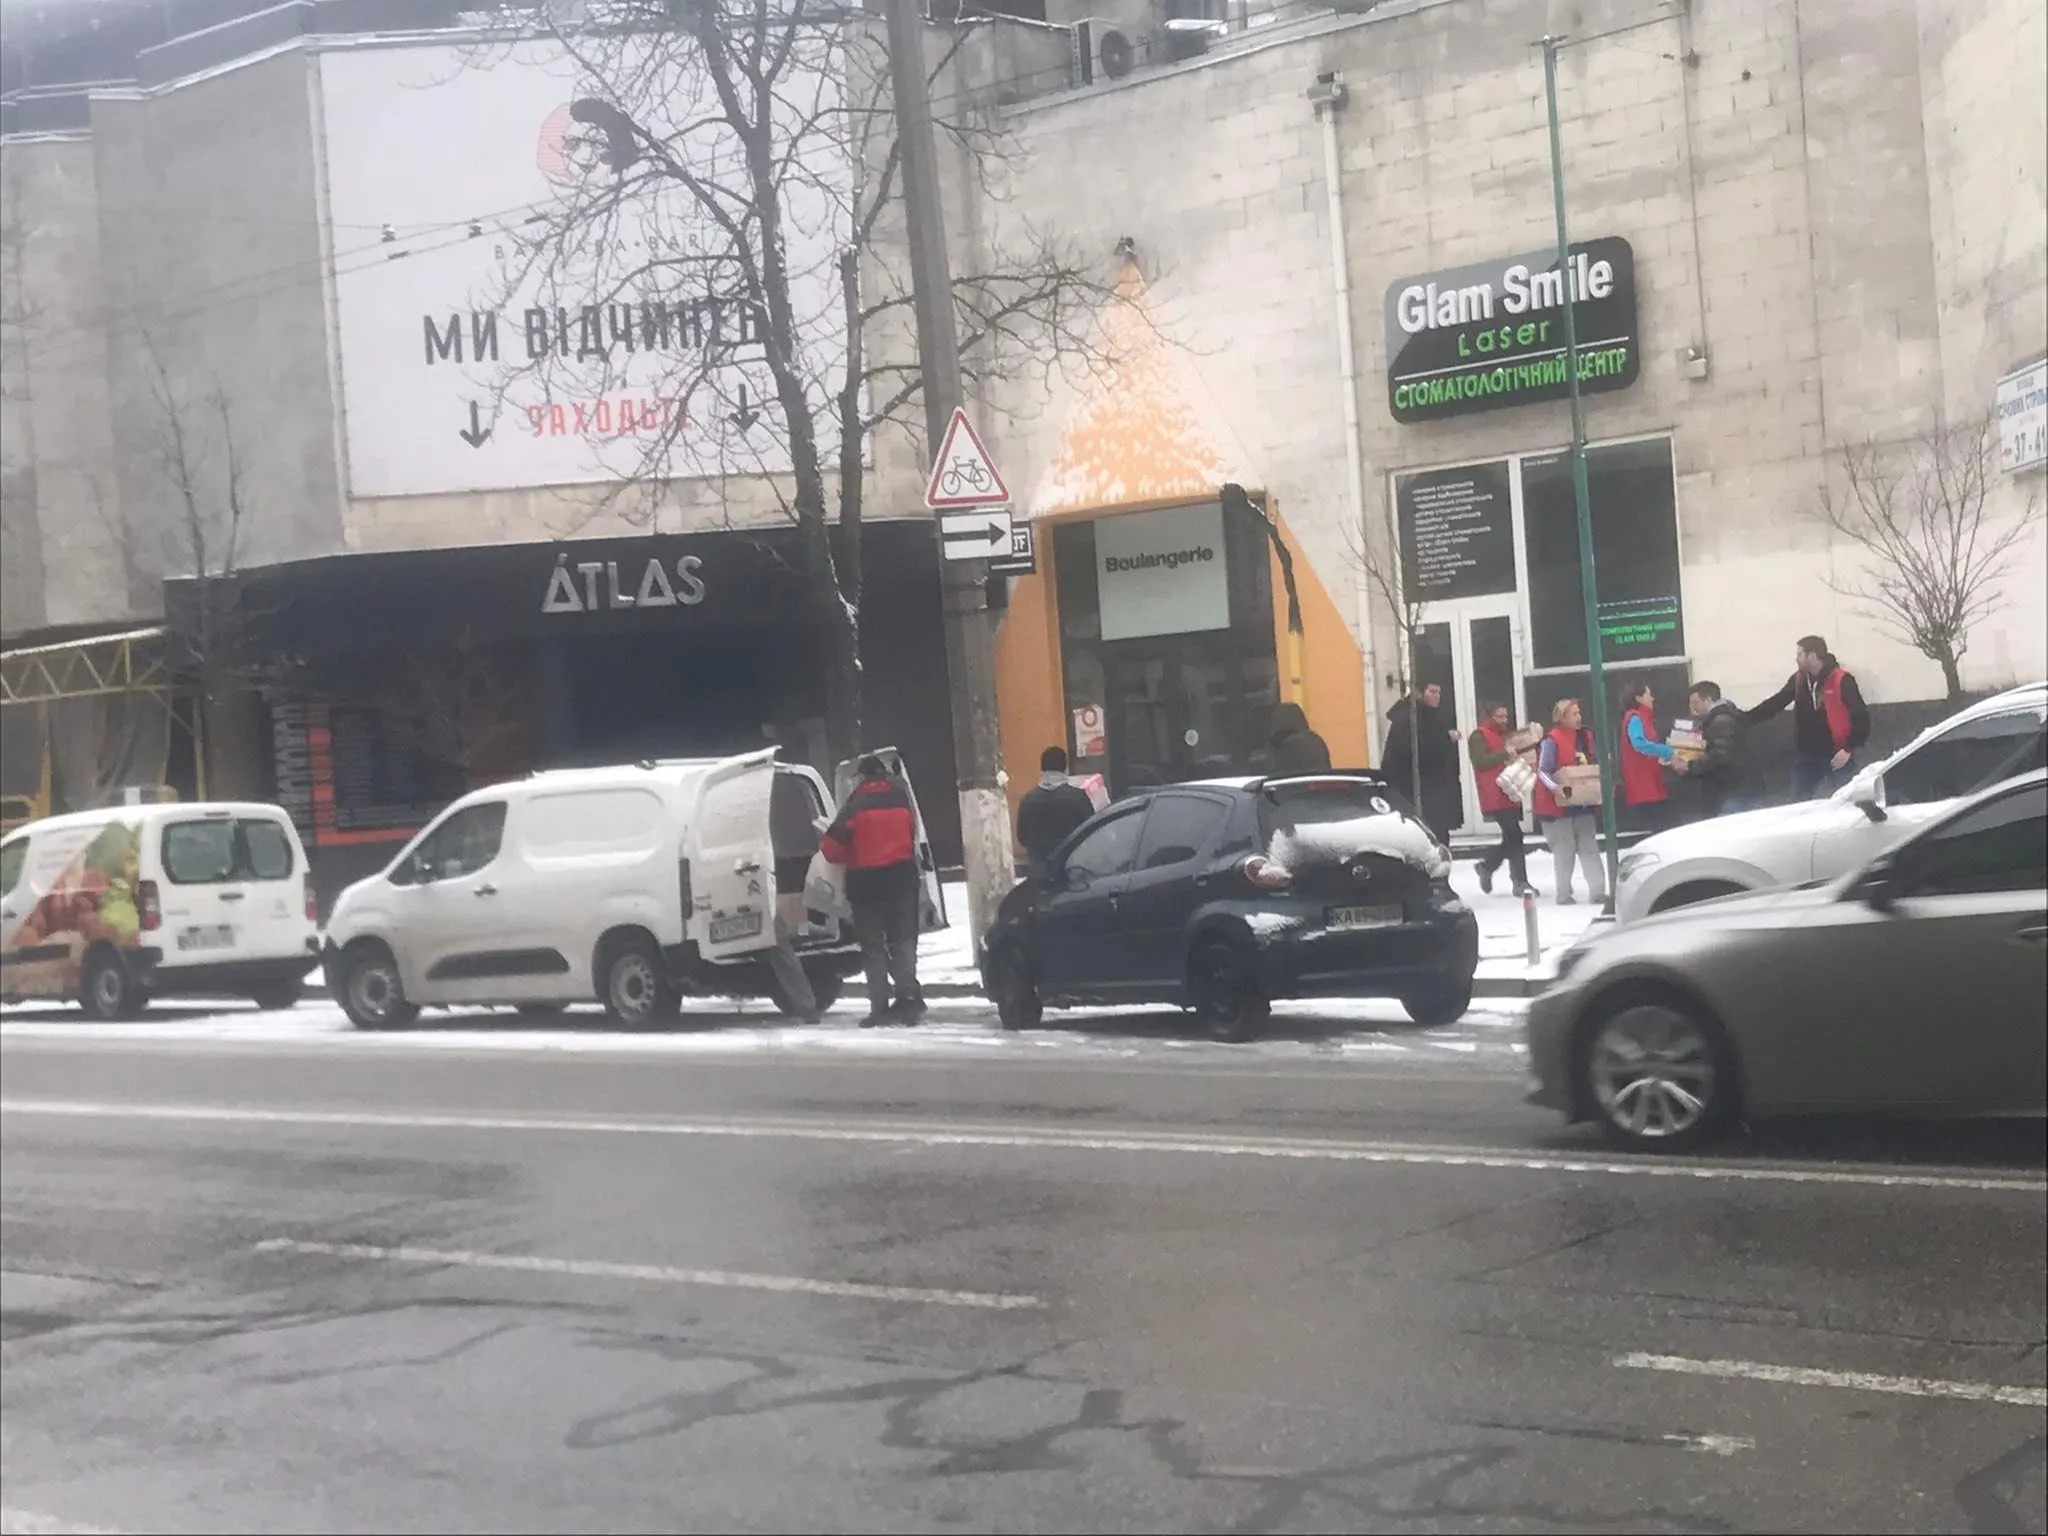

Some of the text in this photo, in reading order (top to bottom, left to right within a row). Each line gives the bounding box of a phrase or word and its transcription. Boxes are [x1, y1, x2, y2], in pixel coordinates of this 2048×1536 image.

[1397, 252, 1614, 334] Glam Smile
[423, 299, 793, 365] МИ ВІДЧИНЕН
[1457, 320, 1550, 357] Laser
[1394, 352, 1568, 410] СТОМАТОЛОГІЧНИЙ
[1105, 545, 1214, 572] Boulangerie
